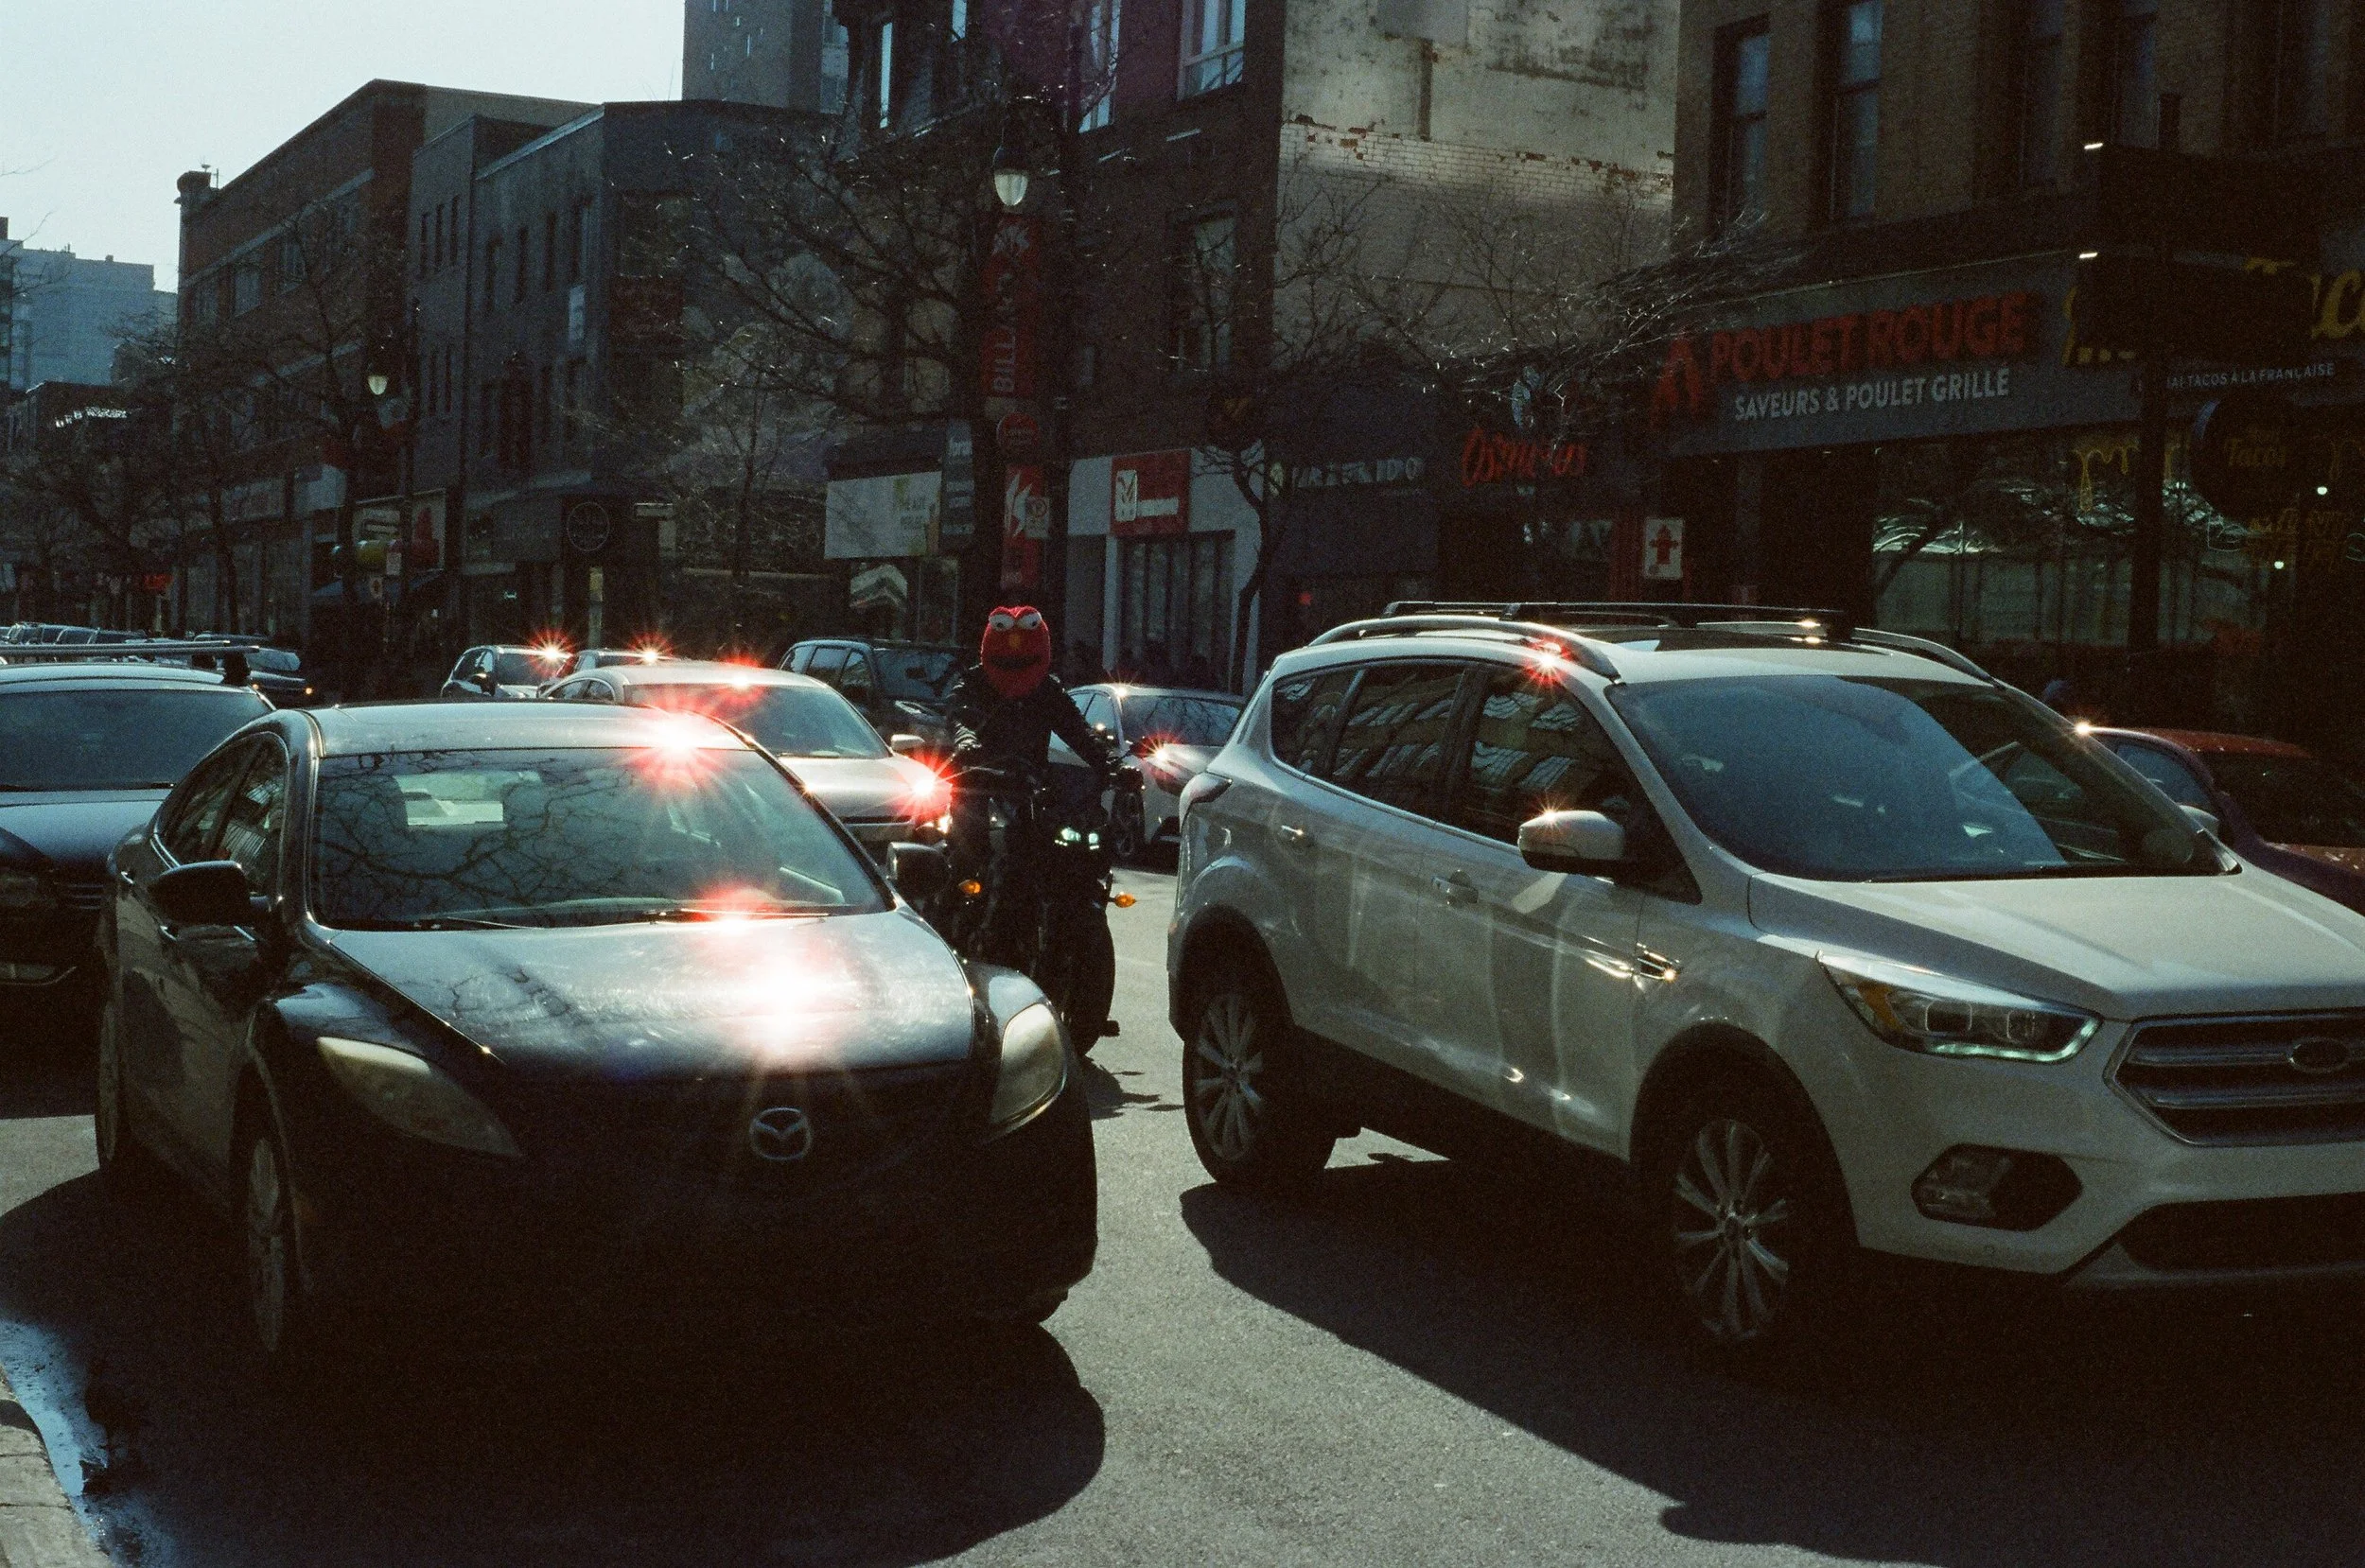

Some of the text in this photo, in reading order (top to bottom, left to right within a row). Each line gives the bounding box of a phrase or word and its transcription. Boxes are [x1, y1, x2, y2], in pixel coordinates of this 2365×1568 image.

[1709, 312, 1858, 385] POULET
[1866, 291, 2027, 369] ROUGE
[1734, 388, 1820, 422] SAVEURS
[1824, 387, 1839, 412] &
[1845, 377, 1926, 412] POULET
[2187, 373, 2229, 387] TACOS
[2241, 370, 2257, 384] LA
